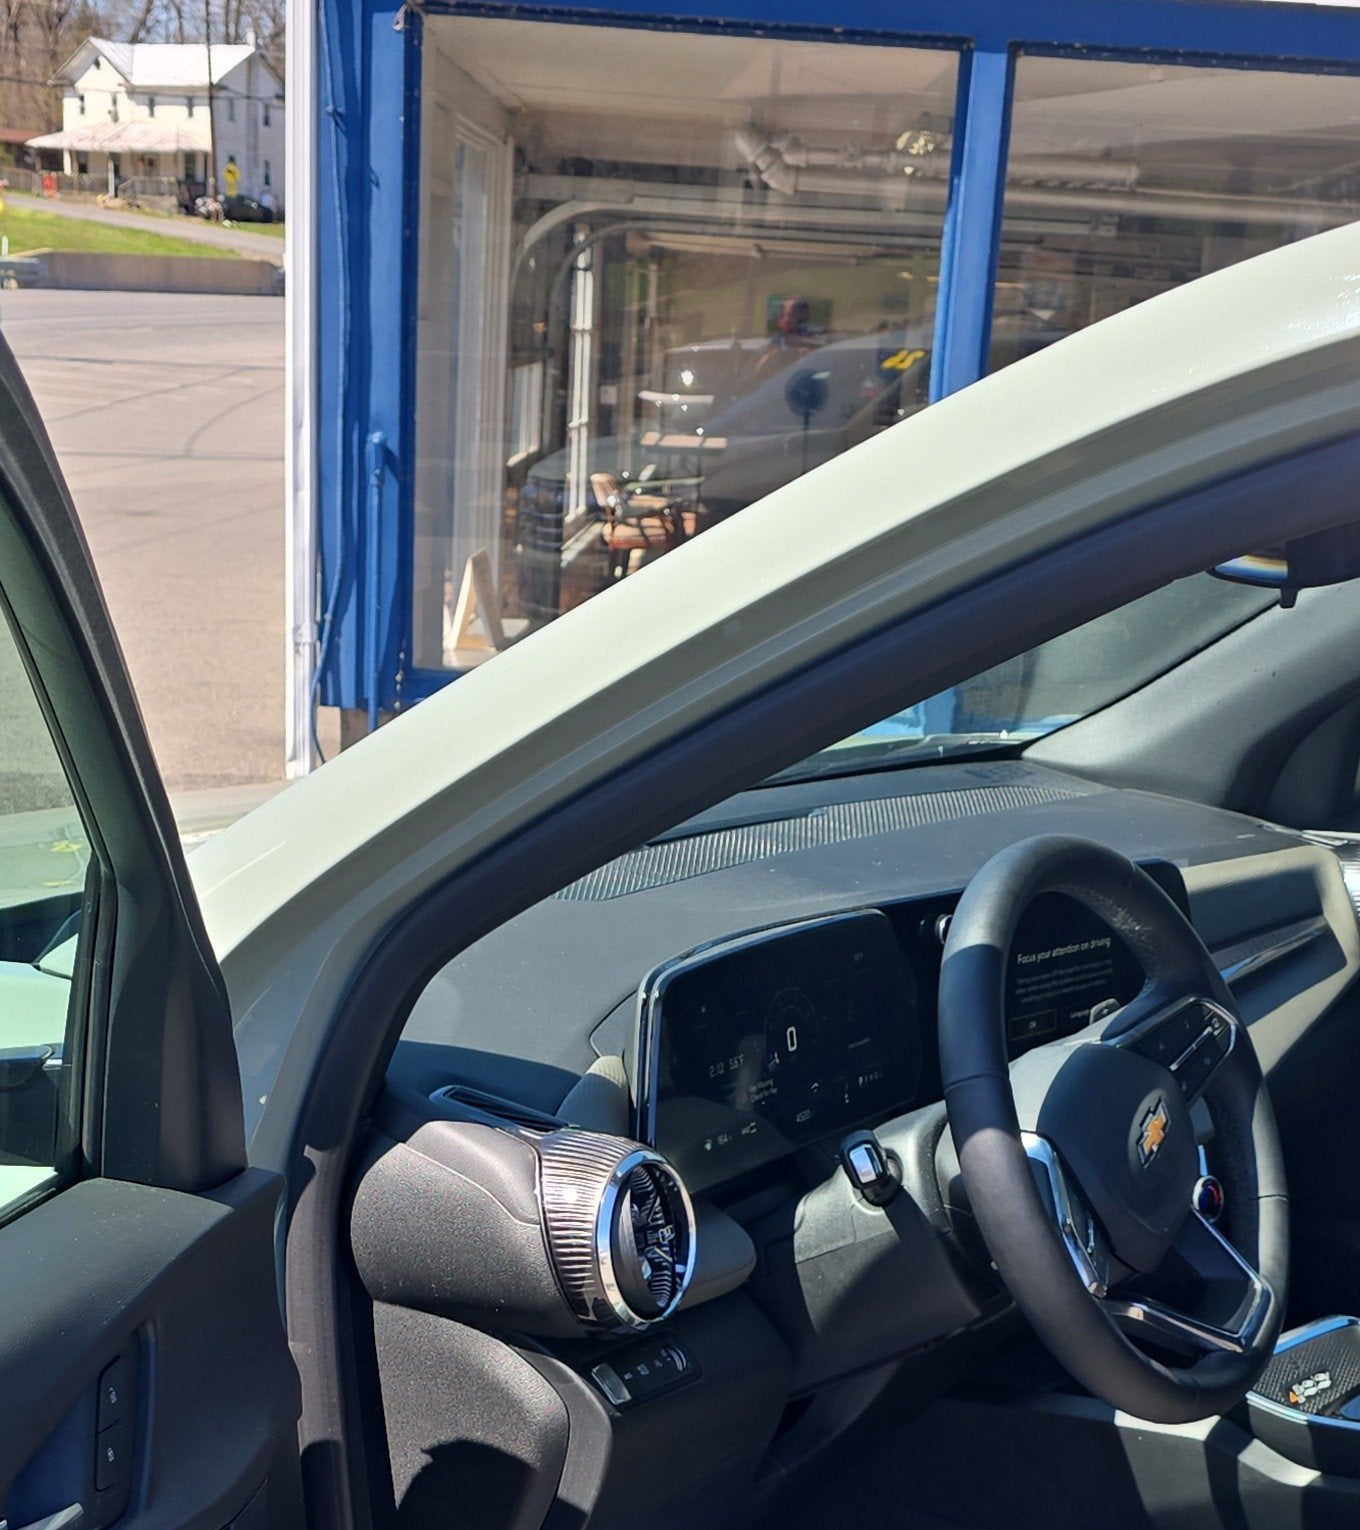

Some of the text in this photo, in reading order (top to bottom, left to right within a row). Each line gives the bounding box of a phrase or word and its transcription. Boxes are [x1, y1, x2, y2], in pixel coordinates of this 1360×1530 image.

[1016, 953, 1037, 965] Focus
[1037, 950, 1051, 963] your
[1051, 943, 1080, 957] attention
[785, 1025, 799, 1053] 0
